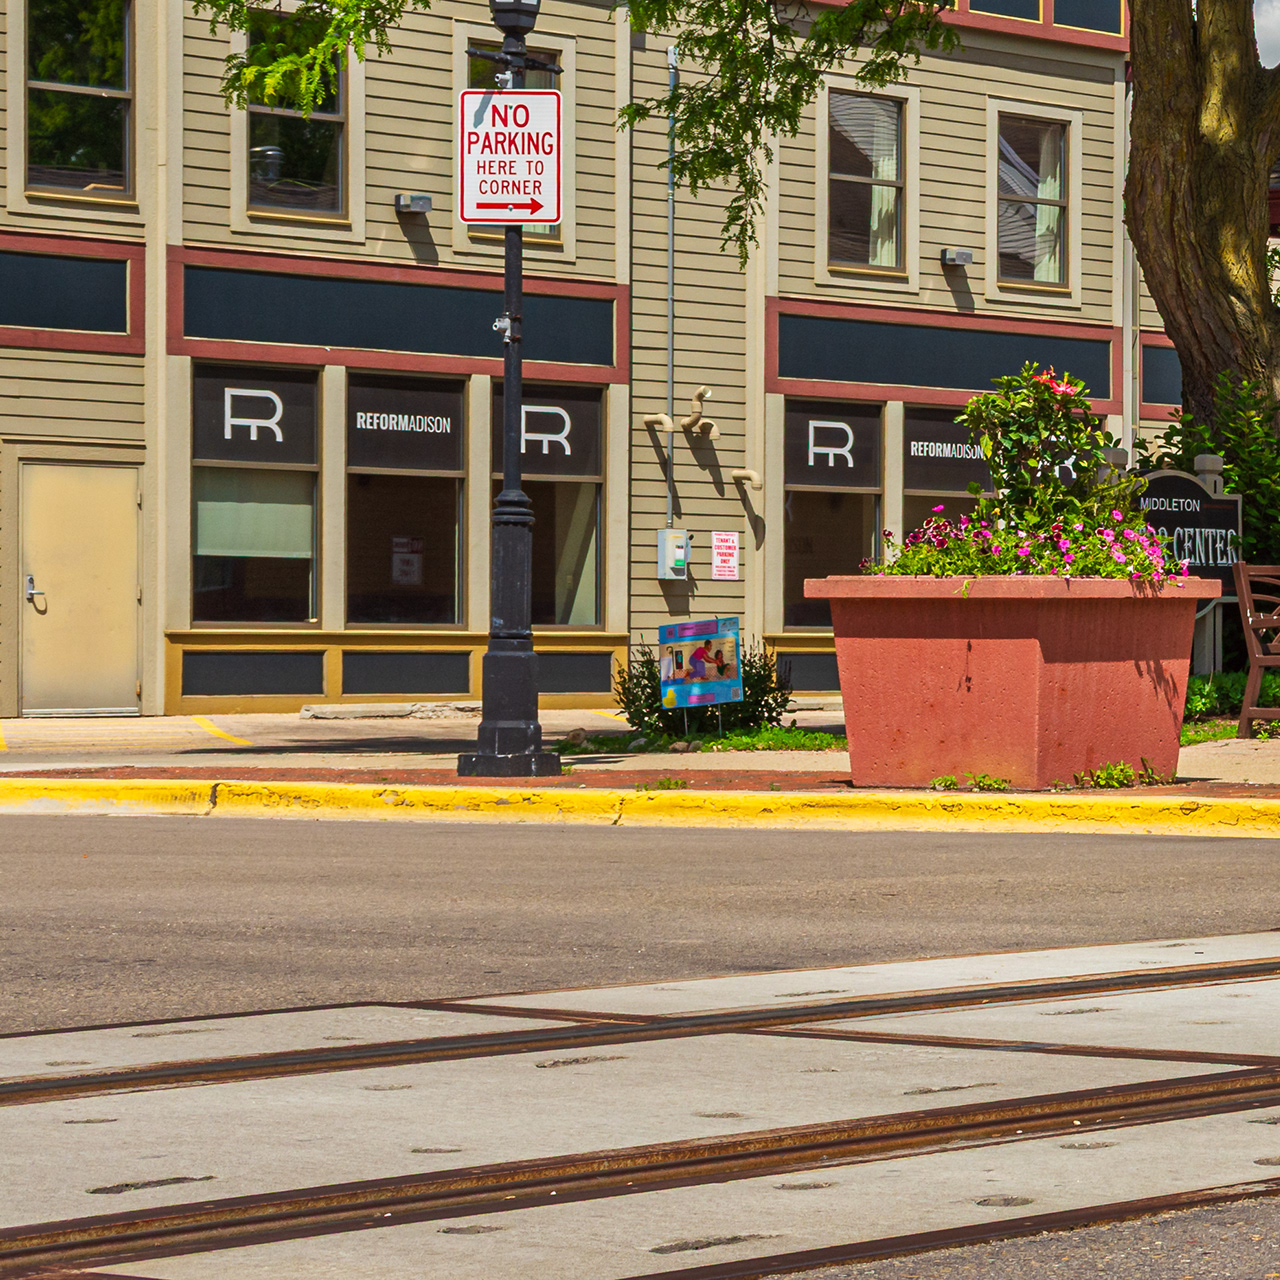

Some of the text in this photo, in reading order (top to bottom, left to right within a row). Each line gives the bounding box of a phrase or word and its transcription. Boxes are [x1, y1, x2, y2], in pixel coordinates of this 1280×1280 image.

[491, 104, 530, 128] NO
[467, 131, 554, 156] PARKING
[476, 160, 544, 175] HERE TO
[479, 179, 542, 195] CORNER
[356, 411, 451, 434] REFORMADISON
[910, 441, 984, 460] REFORMADISON
[1140, 497, 1200, 512] MIDDLETON
[1173, 527, 1238, 567] CENTER
